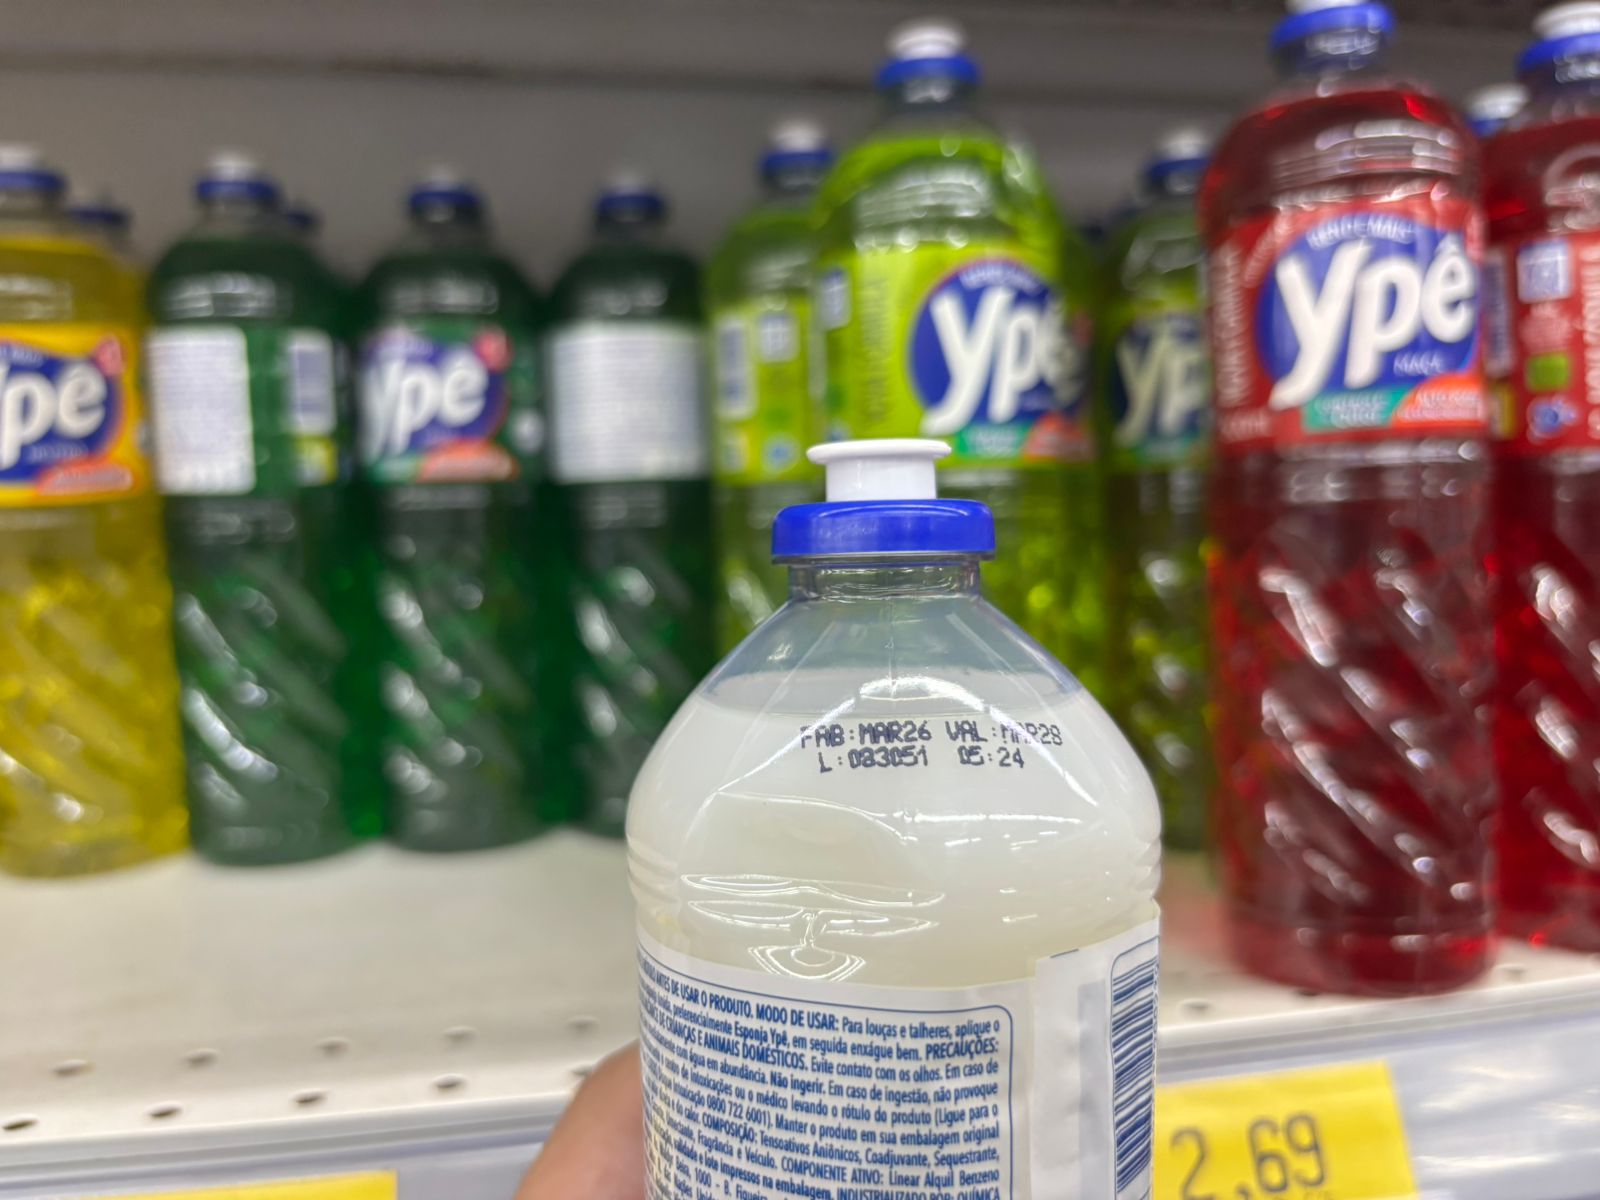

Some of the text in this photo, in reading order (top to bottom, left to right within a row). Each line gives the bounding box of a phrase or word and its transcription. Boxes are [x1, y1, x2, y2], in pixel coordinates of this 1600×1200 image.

[1268, 231, 1476, 411] Ypê
[0, 356, 107, 471] pê
[1112, 332, 1206, 447] Yp
[800, 720, 932, 748] FAB:MAR26
[671, 979, 680, 996] DE
[680, 983, 700, 1004] USAR
[700, 990, 708, 1007] O
[709, 993, 753, 1018] PRODUTO.
[756, 1003, 788, 1025] MODO
[790, 1009, 805, 1027] DE
[807, 1011, 839, 1031] USAR:
[842, 1016, 863, 1034] Para
[865, 1017, 897, 1040] louças
[899, 1025, 906, 1038] e
[909, 1021, 953, 1040] talheres,
[955, 1019, 991, 1038] aplique
[993, 1019, 1000, 1032] o
[673, 1003, 733, 1035] preferencialmente
[734, 1021, 768, 1045] Esponja
[770, 1027, 790, 1049] Ypê,
[792, 1035, 807, 1049] em
[810, 1036, 847, 1056] seguida
[850, 1040, 893, 1062] enxágue
[896, 1041, 922, 1060] bem.
[925, 1036, 999, 1060] PRECAUÇÕES:
[666, 1014, 697, 1045] CRIANÇAS
[697, 1029, 703, 1046] E
[703, 1031, 740, 1057] ANIMAIS
[742, 1041, 808, 1071] DOMÉSTICOS.
[811, 1055, 834, 1074] Evite
[836, 1060, 872, 1079] contato
[875, 1066, 896, 1081] com
[899, 1068, 910, 1082] os
[913, 1064, 943, 1082] olhos.
[945, 1063, 960, 1079] Em
[963, 1062, 983, 1077] caso
[986, 1057, 998, 1074] de
[706, 1057, 718, 1072] em
[720, 1058, 768, 1084] abundância.
[770, 1070, 788, 1088] Não
[790, 1073, 826, 1095] ingerir.
[828, 1080, 843, 1096] Em
[846, 1085, 867, 1100] caso
[870, 1083, 882, 1100] de
[885, 1086, 931, 1107] ingestão,
[933, 1086, 951, 1102] não
[954, 1082, 998, 1104] provoque
[735, 1086, 745, 1099] ou
[748, 1090, 754, 1102] o
[756, 1090, 788, 1110] médico
[791, 1094, 828, 1116] levando
[831, 1105, 838, 1117] o
[841, 1103, 871, 1121] rótulo
[874, 1105, 887, 1122] do
[891, 1108, 932, 1127] produto
[934, 1107, 966, 1127] (Ligue
[969, 1105, 989, 1124] para
[992, 1103, 998, 1117] o
[702, 1112, 757, 1144] COMPOSIÇÃO:
[760, 1129, 810, 1156] Tensoativos
[812, 1141, 862, 1165] Aniônicos,
[865, 1147, 931, 1169] Coadjuvante,
[934, 1146, 1000, 1168] Sequestrante,
[706, 1093, 726, 1114] 0800
[728, 1100, 743, 1119] 722
[745, 1105, 773, 1130] 6001).
[775, 1112, 808, 1134] Manter
[810, 1122, 817, 1135] o
[819, 1121, 857, 1141] produto
[860, 1129, 876, 1143] em
[879, 1131, 897, 1145] sua
[900, 1128, 960, 1149] embalagem
[963, 1119, 1000, 1145] original
[698, 1129, 733, 1157] Fragrância
[737, 1147, 742, 1159] e
[745, 1145, 778, 1169] Veículo.
[781, 1155, 847, 1182] COMPONENTE
[850, 1168, 883, 1184] ATIVO:
[889, 1169, 920, 1187] Linear
[924, 1170, 954, 1192] Alquil
[959, 1169, 1000, 1186] Benzeno
[720, 1157, 760, 1185] impressos
[762, 1175, 773, 1189] na
